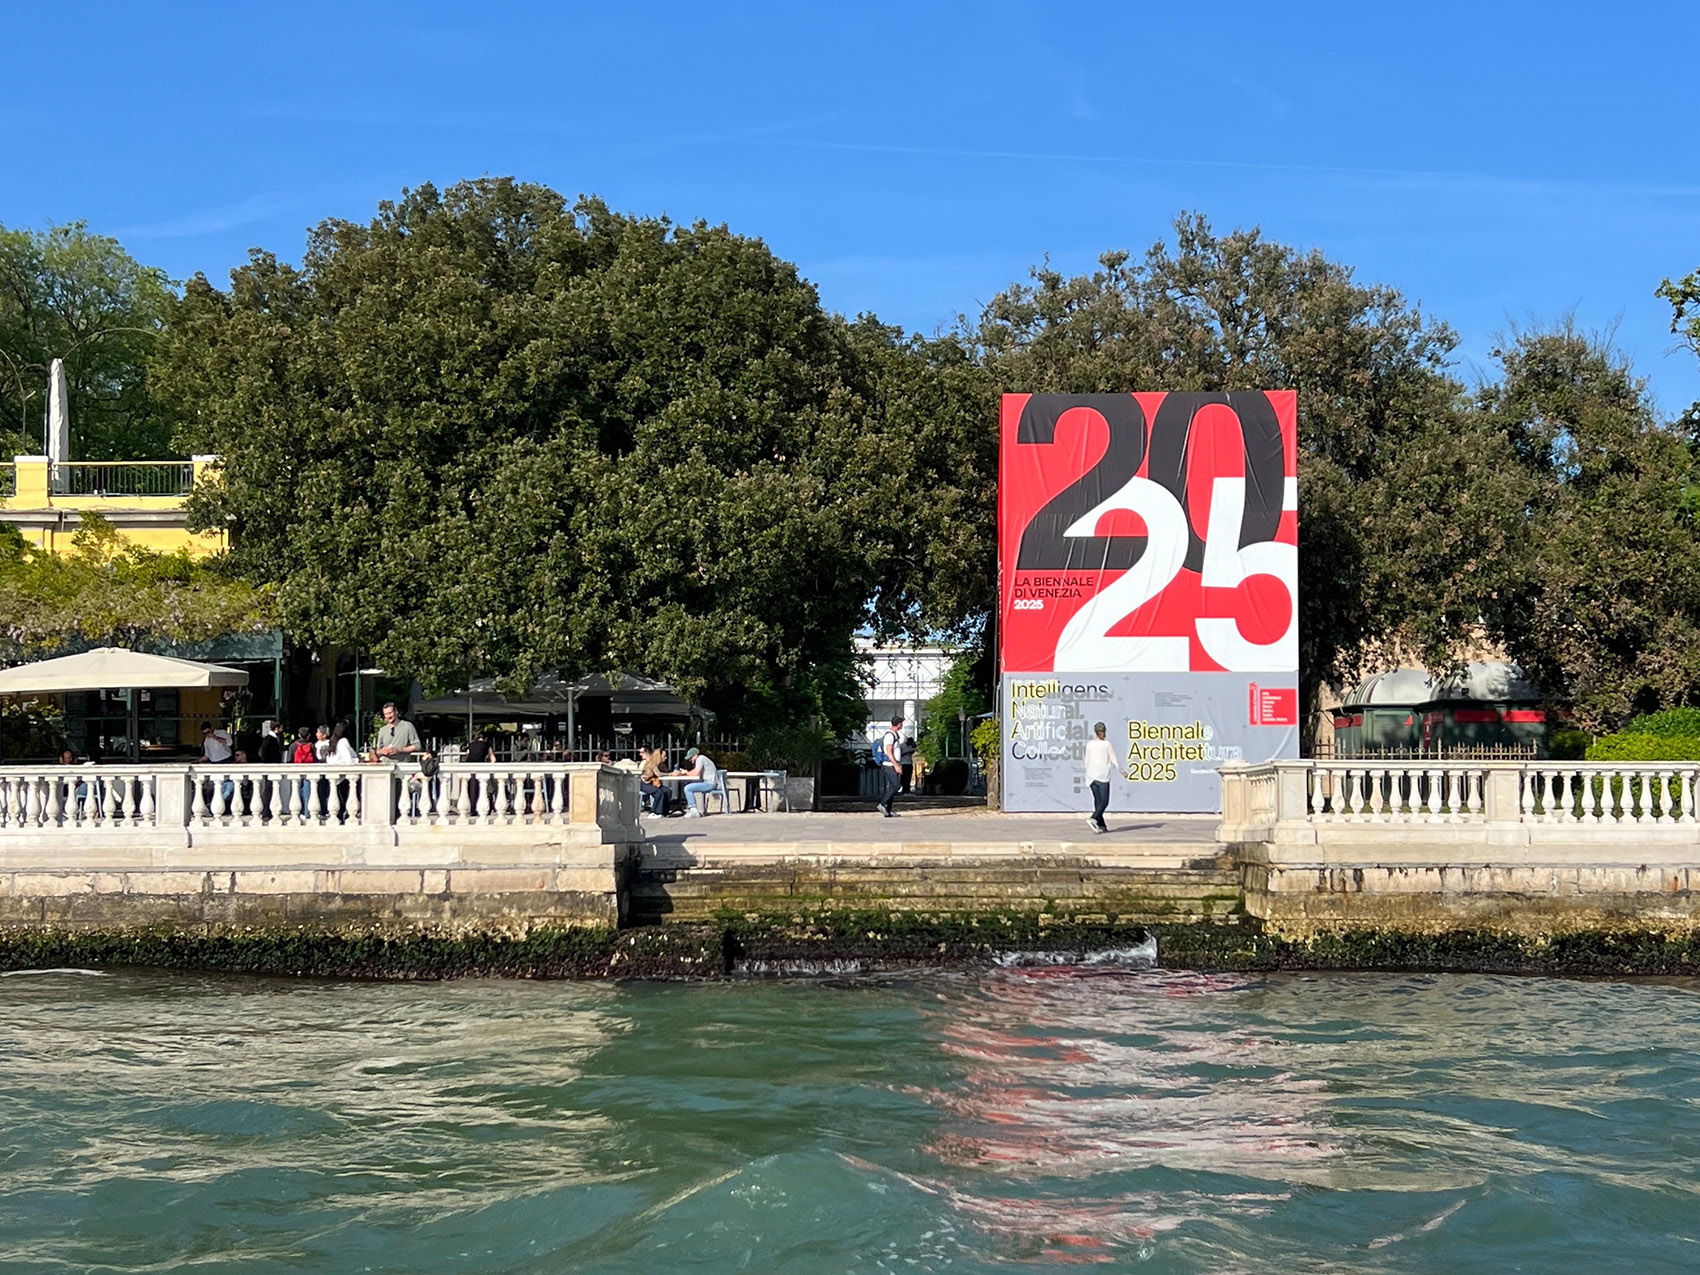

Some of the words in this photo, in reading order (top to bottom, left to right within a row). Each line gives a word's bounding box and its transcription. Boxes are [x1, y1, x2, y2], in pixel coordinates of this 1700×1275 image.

[1016, 392, 1286, 574] 20
[1014, 577, 1031, 587] LA
[1033, 577, 1094, 587] BIENNALE
[1053, 476, 1298, 672] 25
[1014, 588, 1027, 598] DI
[1029, 588, 1082, 598] VENEZIA
[1013, 599, 1044, 610] 2025
[1128, 720, 1214, 741] Biennale
[1011, 741, 1088, 761] Collecti
[1127, 742, 1243, 762] Architettura
[1128, 762, 1178, 782] 2025
